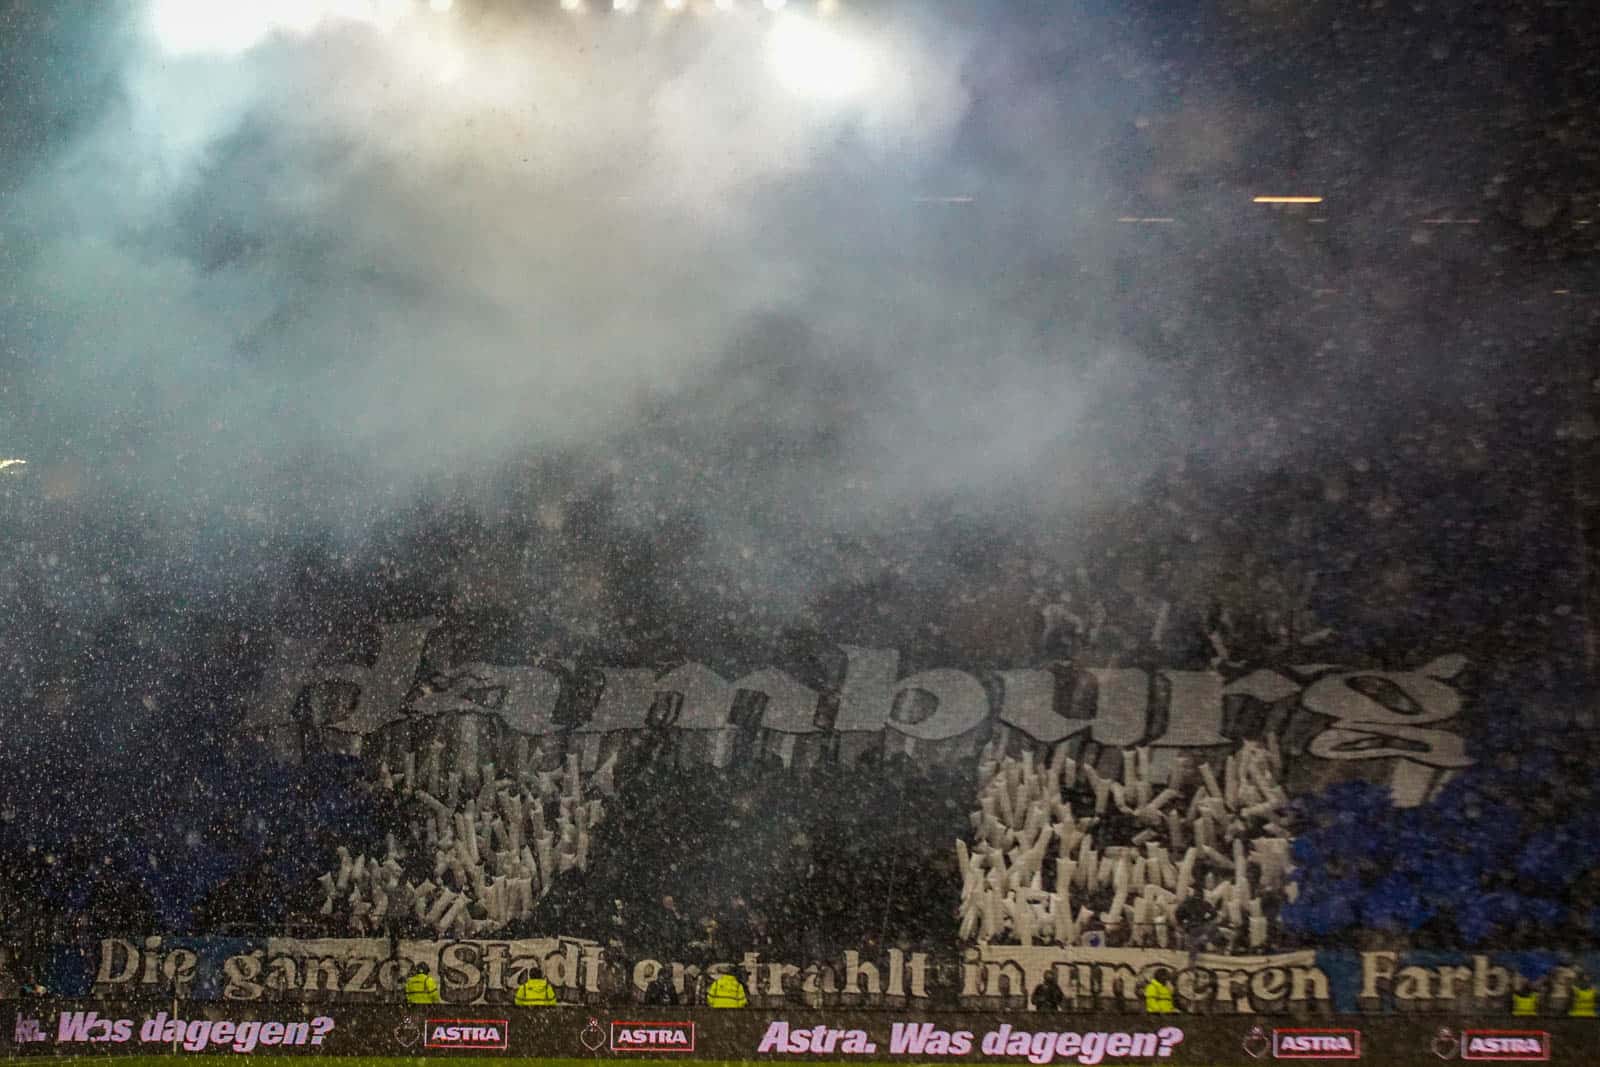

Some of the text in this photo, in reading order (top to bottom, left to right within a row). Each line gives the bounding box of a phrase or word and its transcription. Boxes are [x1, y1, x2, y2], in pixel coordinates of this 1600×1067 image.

[97, 936, 197, 983] Die
[962, 949, 1024, 997] in
[1053, 962, 1329, 1001] uneren
[141, 1012, 335, 1054] dagegen?
[431, 1026, 501, 1042] ASTRA
[617, 1029, 688, 1045] ASTRA
[758, 1021, 1184, 1065] Astra. Was dagegen?
[1280, 1036, 1353, 1052] ASTRA
[1469, 1037, 1543, 1054] ASTRA
